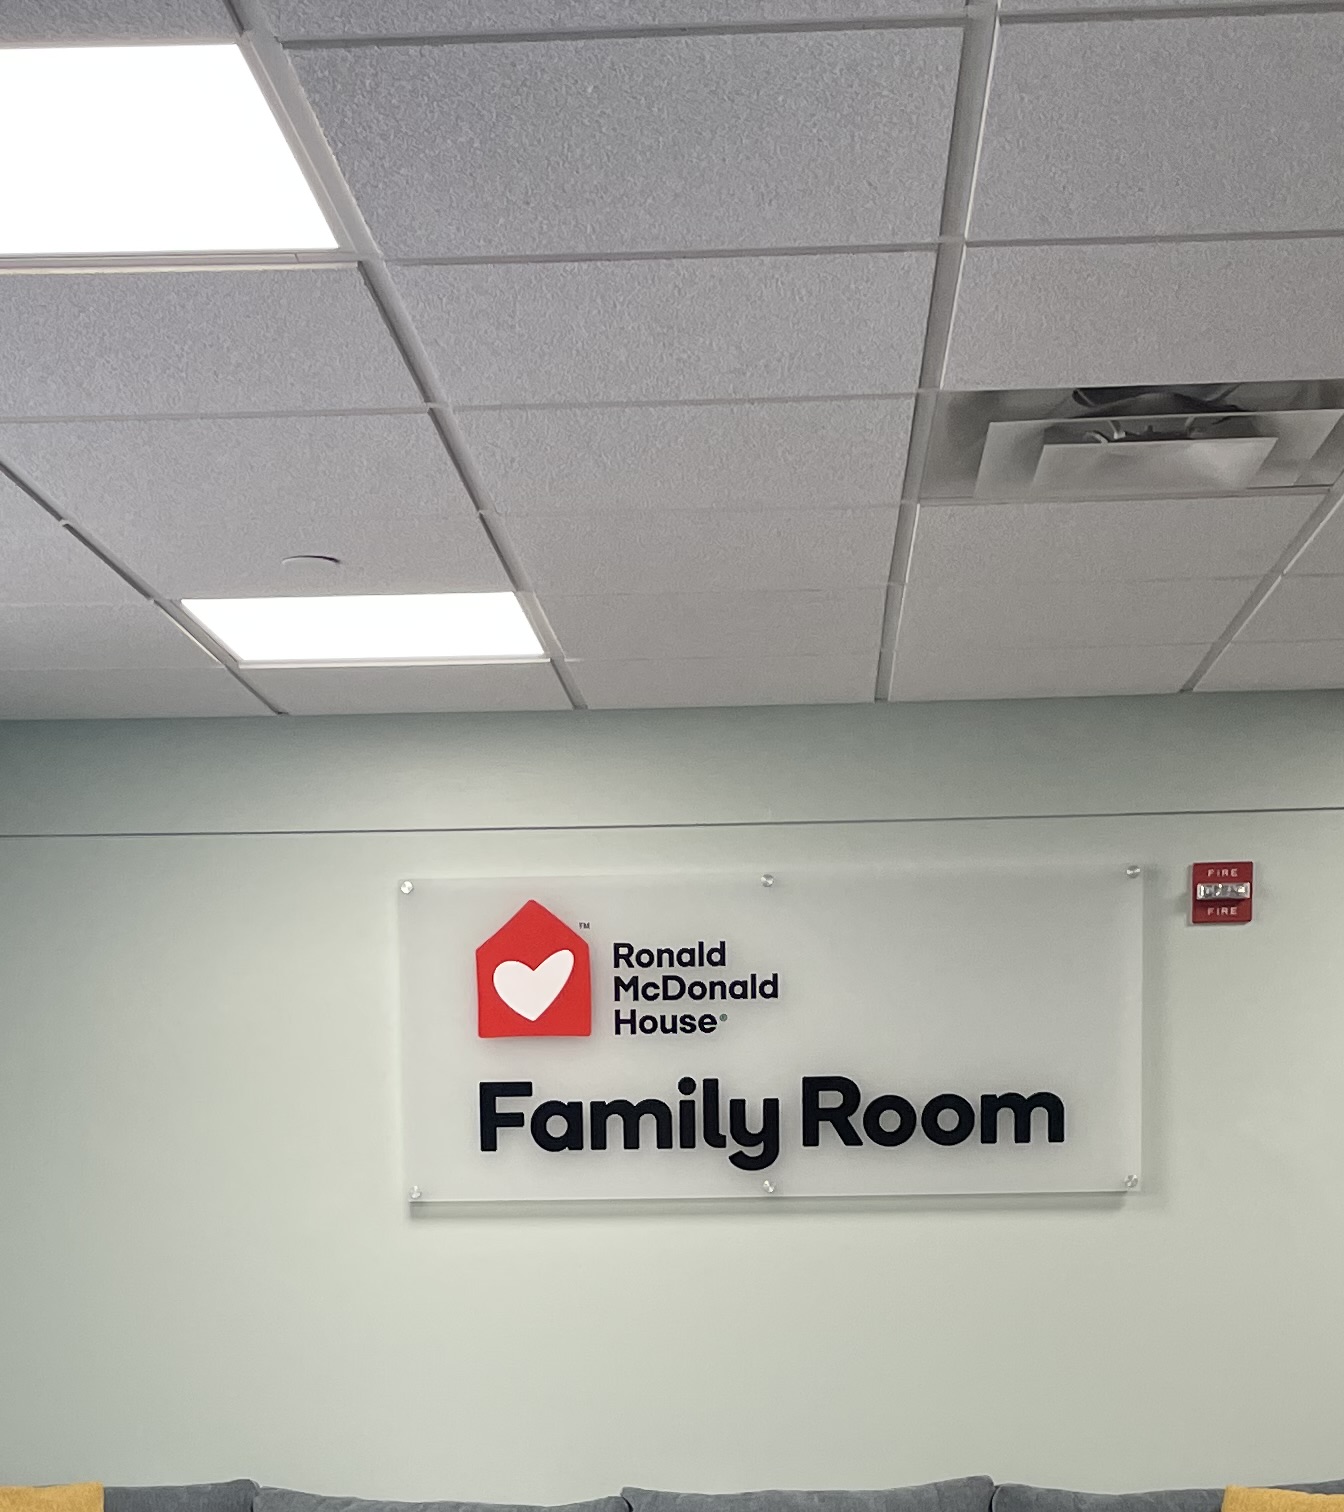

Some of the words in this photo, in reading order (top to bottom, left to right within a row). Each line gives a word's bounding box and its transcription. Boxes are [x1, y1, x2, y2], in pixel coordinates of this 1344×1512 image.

[1207, 868, 1238, 877] FIRE
[1207, 907, 1237, 916] FIRE
[613, 941, 726, 968] Ronald
[613, 973, 779, 1001] McDonald
[479, 1077, 780, 1172] Family
[801, 1076, 1066, 1148] Room
